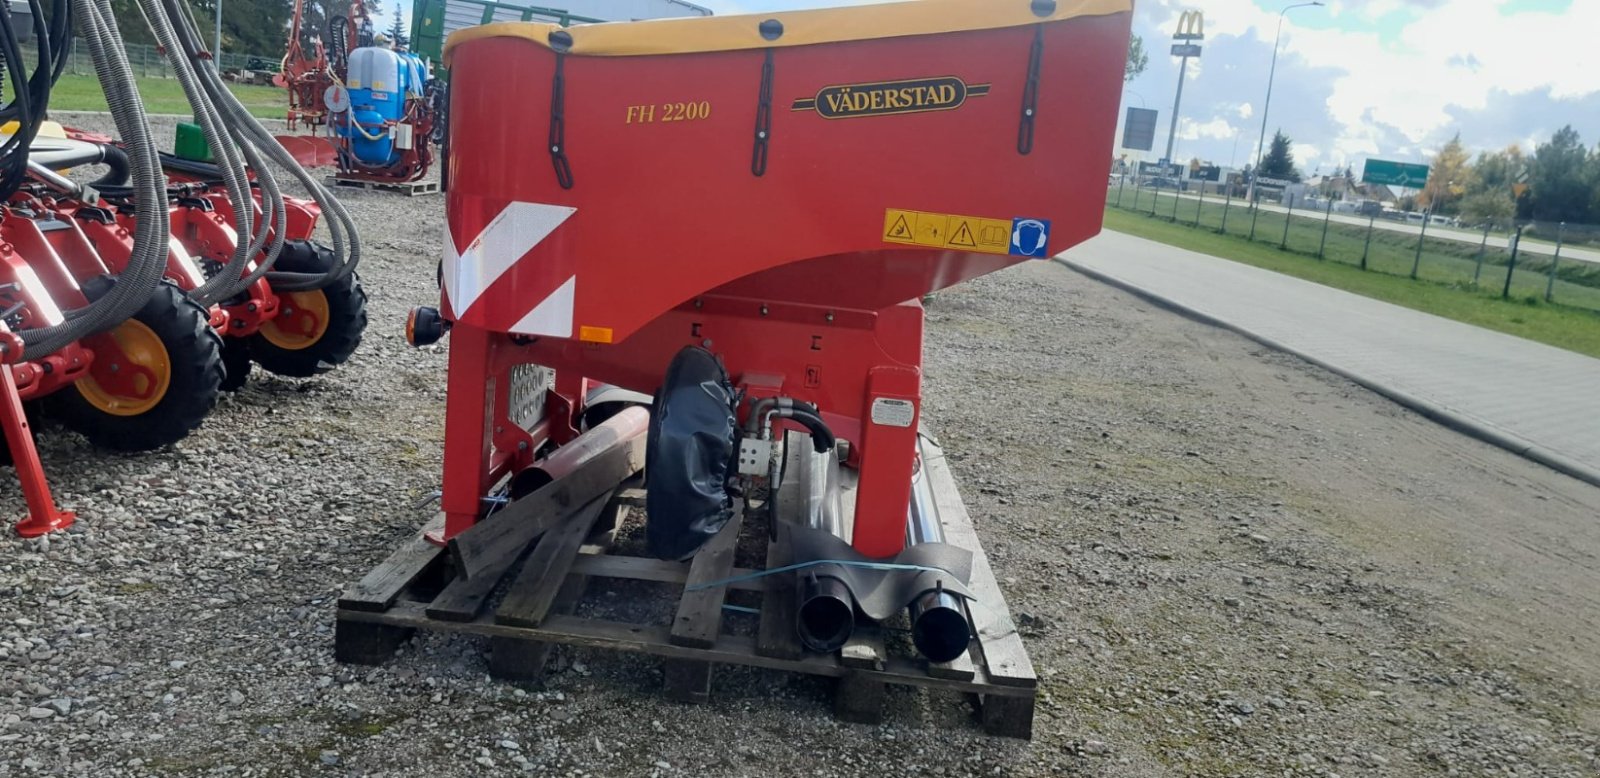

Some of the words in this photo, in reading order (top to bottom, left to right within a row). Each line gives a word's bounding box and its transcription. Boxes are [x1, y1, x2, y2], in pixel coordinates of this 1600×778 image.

[625, 104, 655, 123] FH
[661, 100, 710, 122] 2200
[826, 84, 956, 113] VÄDERSTAD
